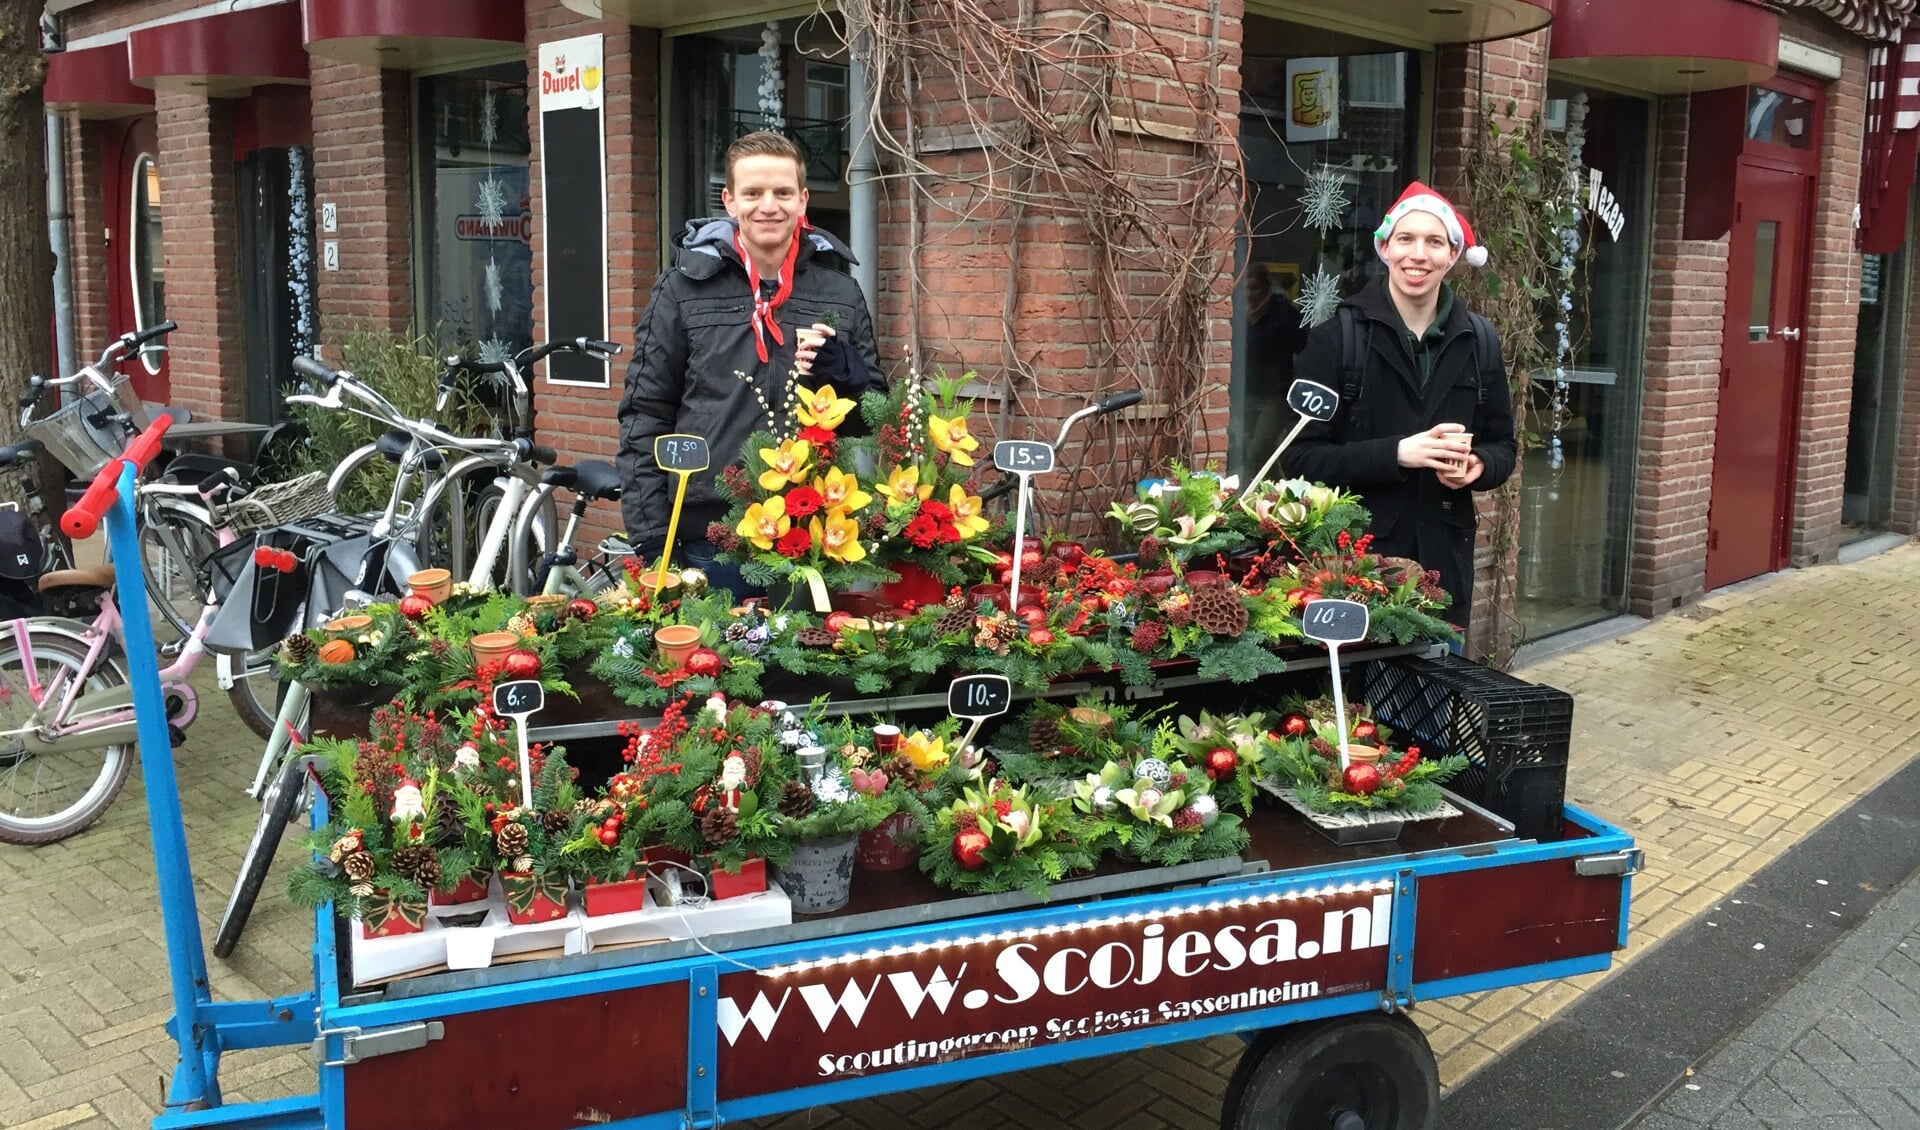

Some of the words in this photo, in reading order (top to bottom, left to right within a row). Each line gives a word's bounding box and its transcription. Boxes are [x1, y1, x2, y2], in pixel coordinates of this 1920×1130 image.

[543, 66, 580, 95] Duvel
[324, 208, 335, 228] 2A
[1588, 167, 1625, 243] Wezen
[327, 246, 335, 267] 2
[717, 893, 1392, 1047] www.Scojesa.nl
[1158, 981, 1319, 1020] Sassenheim
